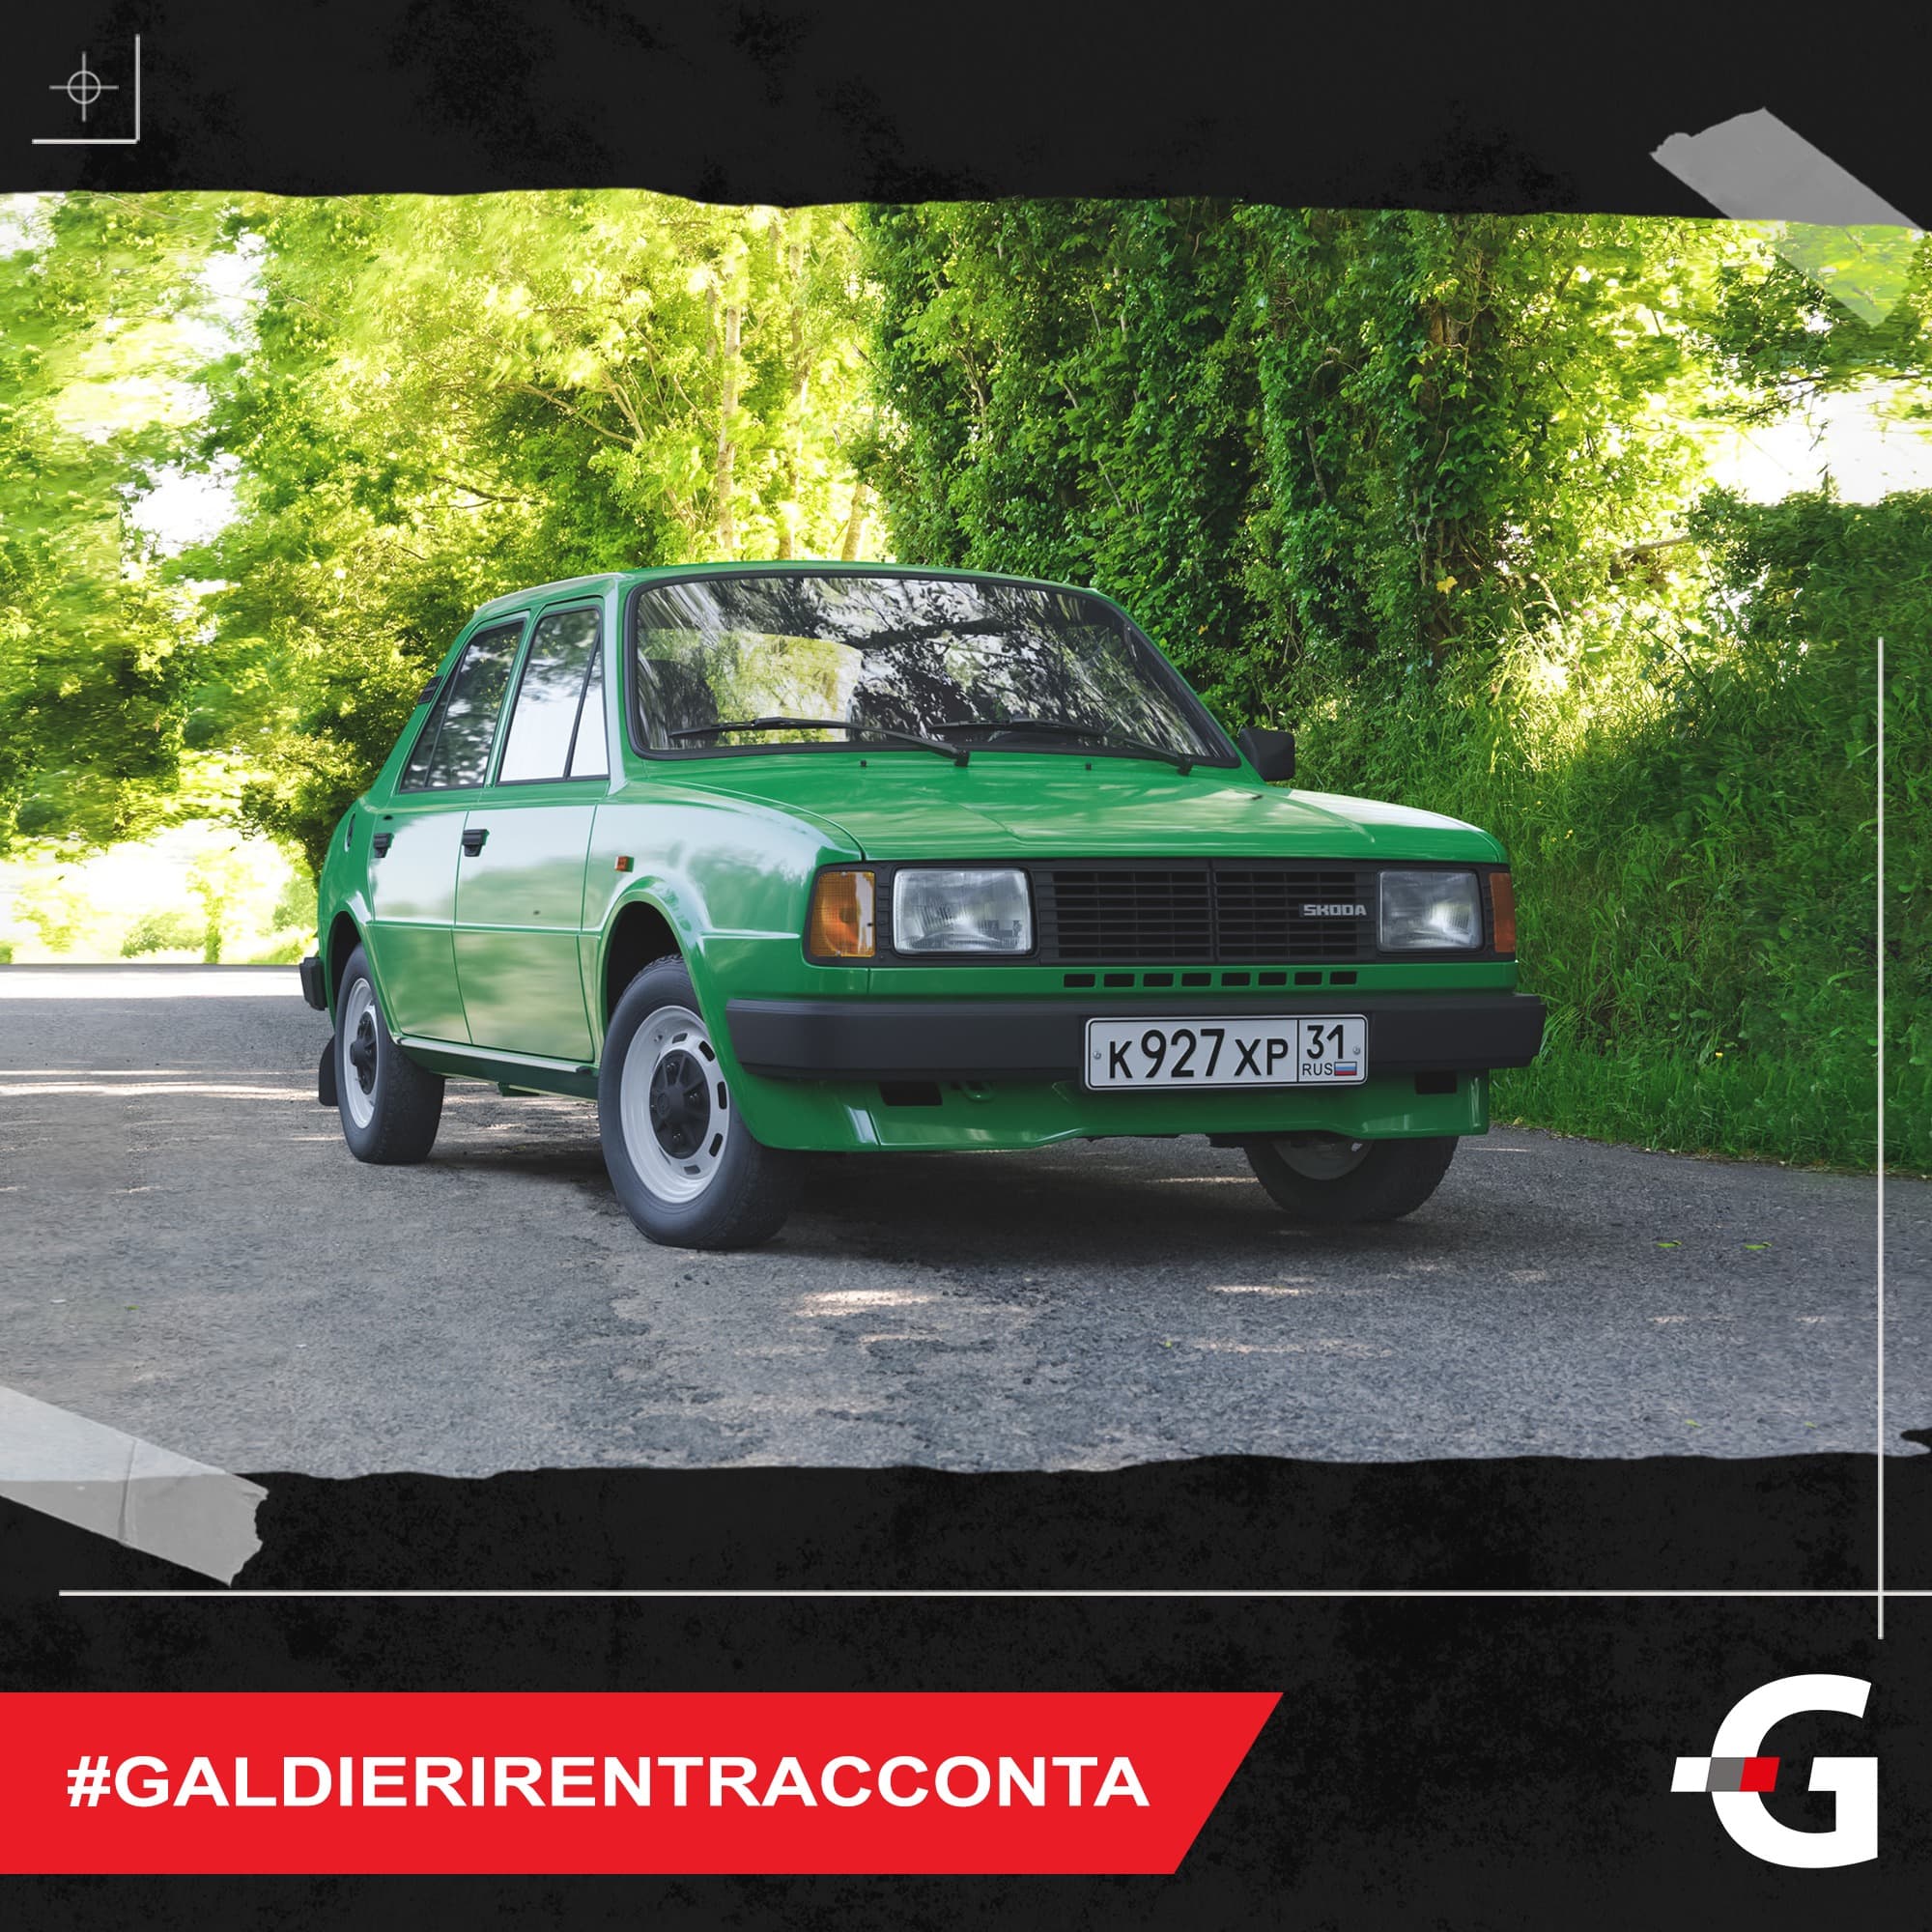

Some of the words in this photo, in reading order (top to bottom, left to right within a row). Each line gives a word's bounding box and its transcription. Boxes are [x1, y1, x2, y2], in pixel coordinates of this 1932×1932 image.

[1303, 903, 1367, 917] SKODA
[1306, 1024, 1345, 1060] 31
[1301, 1063, 1333, 1076] RUS
